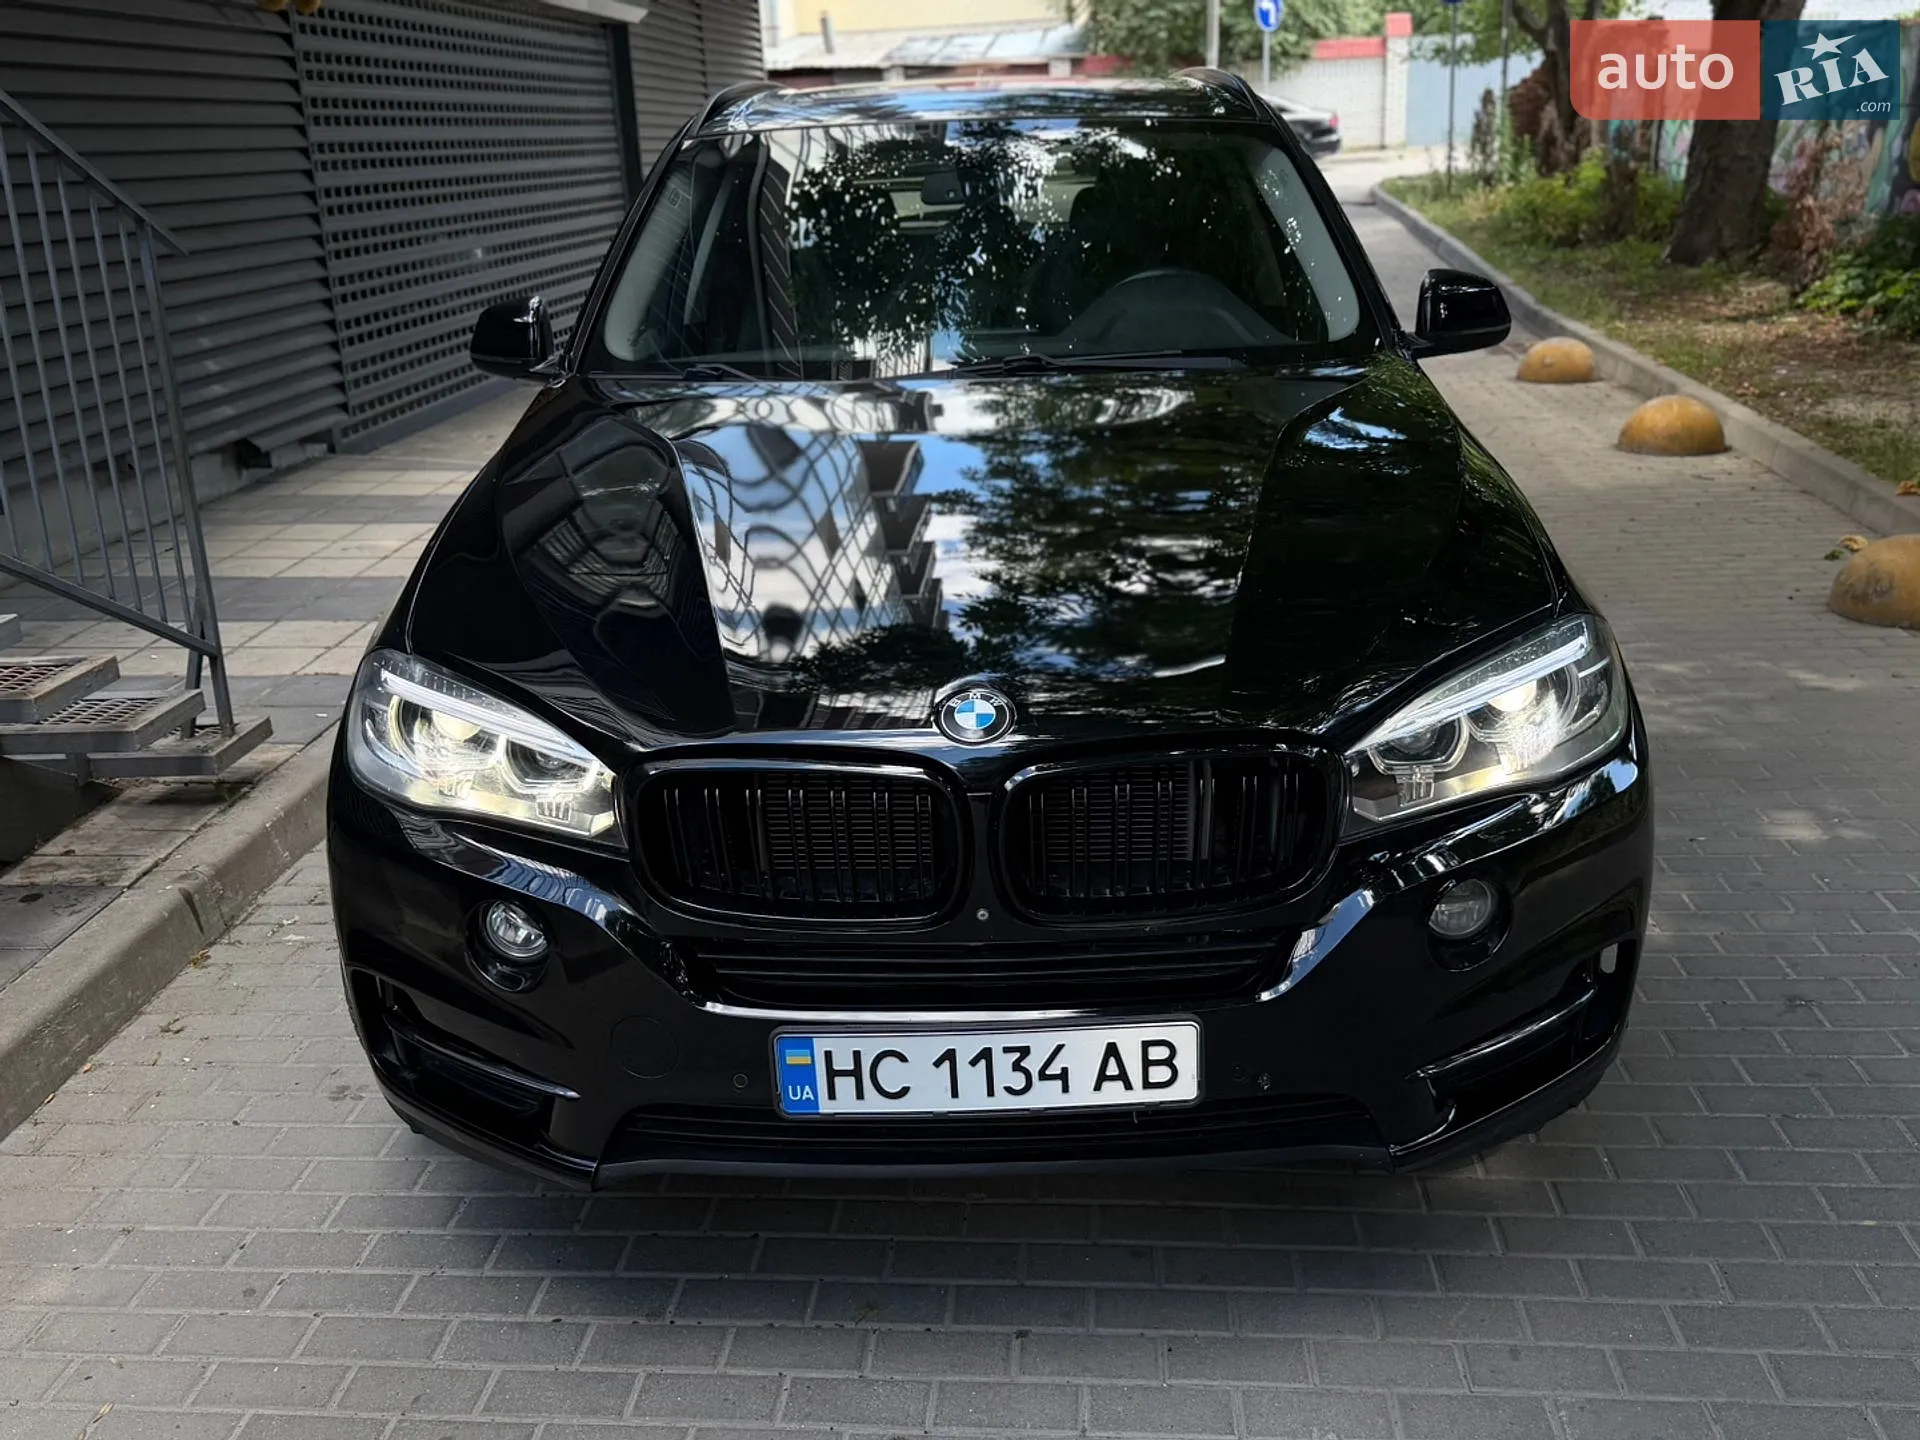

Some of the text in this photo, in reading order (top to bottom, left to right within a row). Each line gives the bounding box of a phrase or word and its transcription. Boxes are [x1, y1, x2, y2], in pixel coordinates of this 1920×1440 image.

[948, 692, 1004, 707] BMW
[823, 1038, 1179, 1101] HC 1134 AB
[788, 1085, 814, 1100] UA
